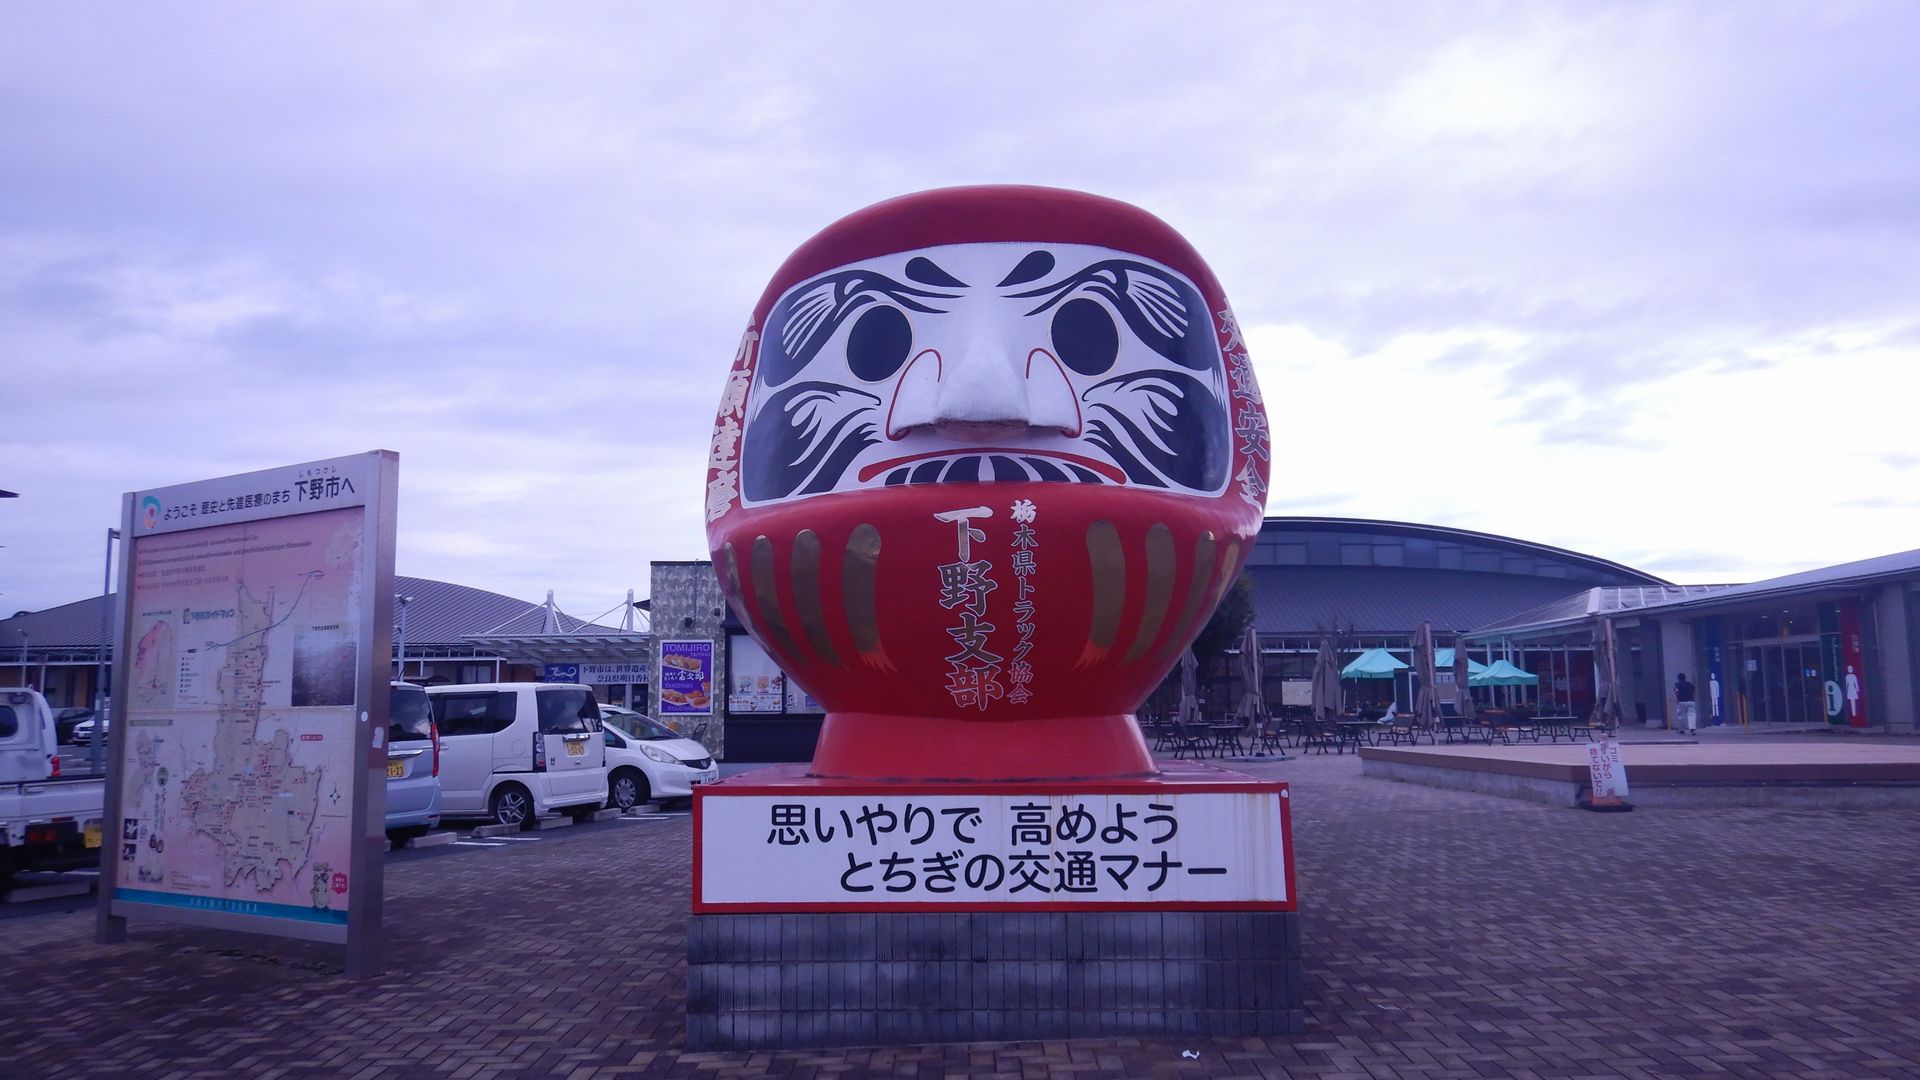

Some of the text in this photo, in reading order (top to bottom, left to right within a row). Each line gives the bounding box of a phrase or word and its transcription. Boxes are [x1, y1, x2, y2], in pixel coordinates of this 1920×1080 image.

[163, 475, 355, 521] ようこそ 歴史と先進医療のまち 下野市へ
[933, 505, 1004, 711] 下野支部
[1007, 498, 1039, 705] 栃木県トラック協会
[664, 644, 711, 652] TOMIJIRO
[767, 803, 1179, 846] 思いやりで 高めよう
[841, 851, 1228, 894] とちぎの交通マナー
